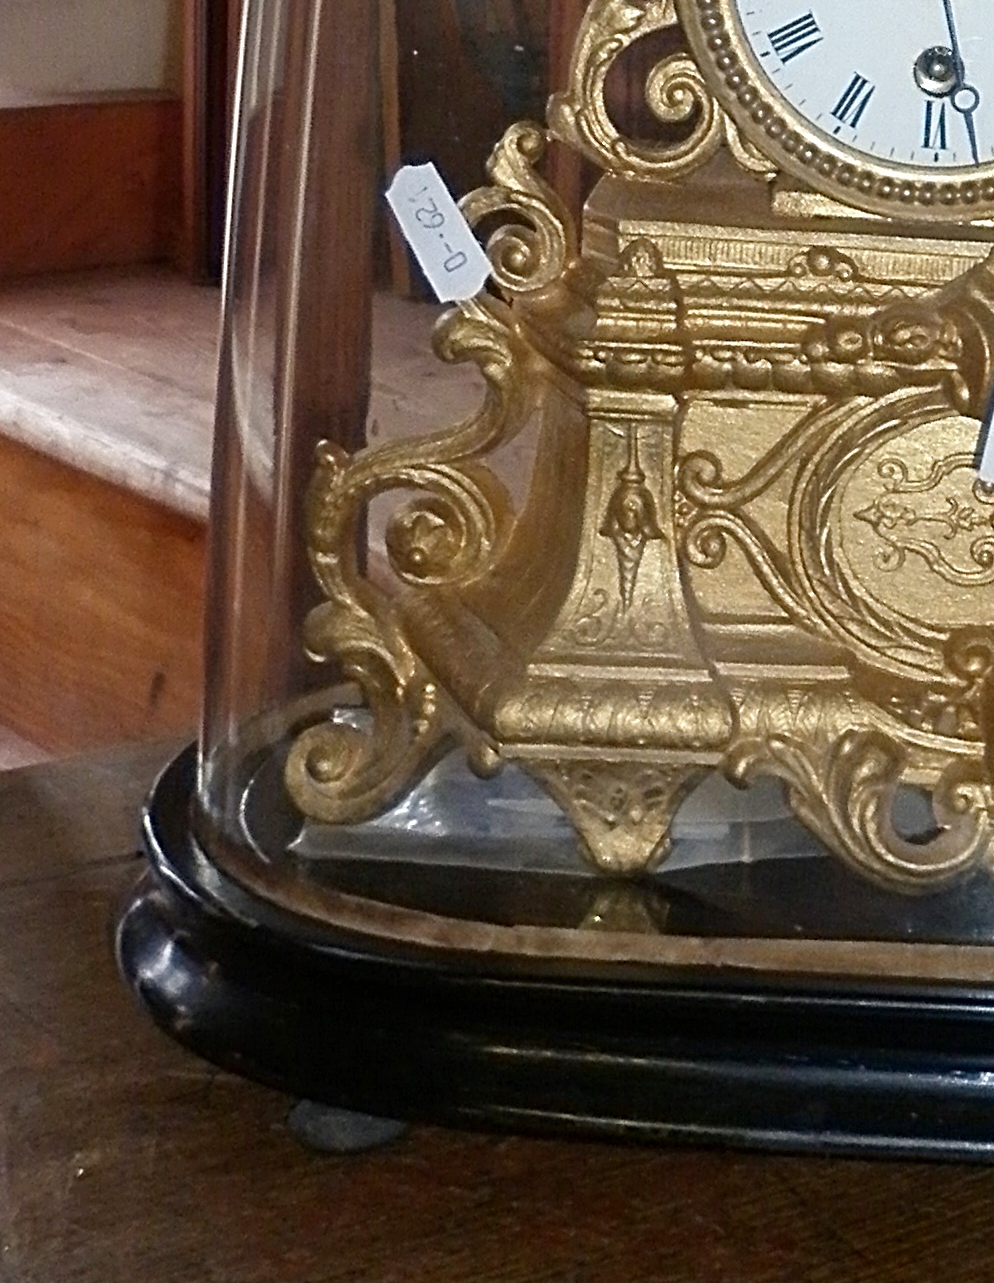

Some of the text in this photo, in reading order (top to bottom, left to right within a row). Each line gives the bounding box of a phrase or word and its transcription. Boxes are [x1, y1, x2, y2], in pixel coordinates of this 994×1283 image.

[768, 10, 823, 64] VIII
[831, 71, 876, 128] VII
[921, 99, 949, 150] VI
